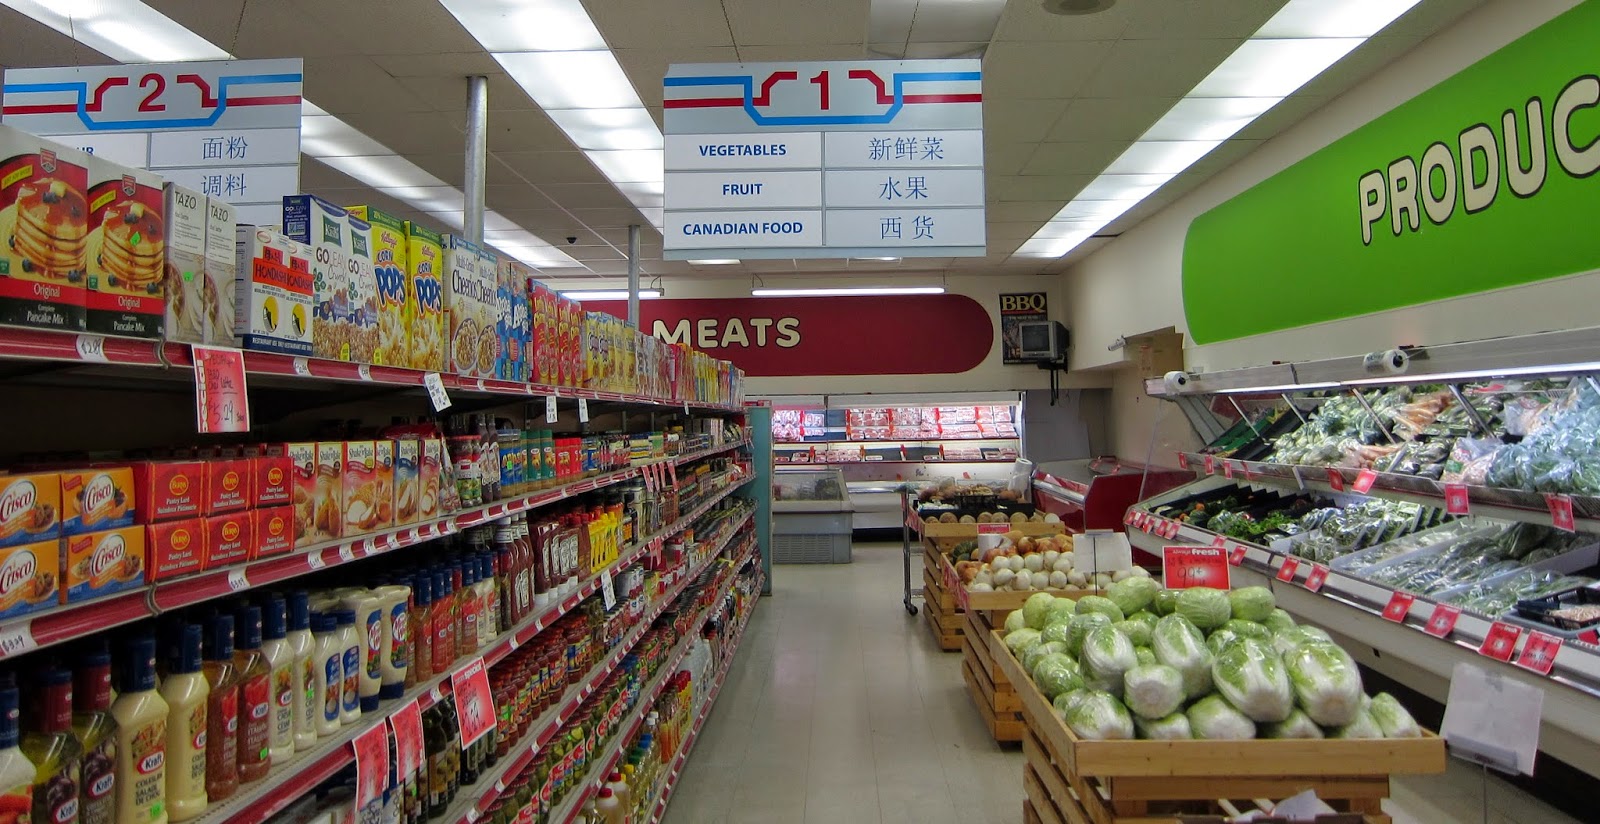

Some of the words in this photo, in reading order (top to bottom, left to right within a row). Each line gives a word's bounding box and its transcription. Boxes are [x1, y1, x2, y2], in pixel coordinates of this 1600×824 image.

[138, 73, 166, 112] 2
[810, 71, 828, 110] 1
[202, 135, 248, 160] 面粉
[699, 144, 786, 157] VEGETABLES
[868, 137, 944, 161] 新鲜菜
[201, 173, 247, 197] 调料
[722, 183, 763, 196] FRUIT
[879, 176, 928, 201] 水果
[174, 191, 197, 210] TAZO
[210, 205, 229, 222] TAZO
[683, 223, 759, 236] CANADIAN
[762, 222, 803, 234] FOOD
[377, 249, 393, 262] CORN
[33, 282, 61, 300] Original
[374, 265, 406, 307] POPS
[414, 276, 442, 316] POPS
[118, 295, 141, 310] Original
[1001, 293, 1046, 313] BBQ
[26, 310, 52, 324] Pancake
[52, 314, 65, 325] Mix
[113, 320, 135, 331] Pancake
[135, 322, 145, 332] Mix
[652, 317, 801, 349] MEATS
[0, 490, 32, 523] Crisco
[87, 483, 112, 511] Crisco
[95, 543, 122, 575] Crisco
[0, 560, 32, 595] Crisco
[145, 753, 162, 769] Kraft
[96, 775, 113, 792] Kraft
[60, 800, 77, 819] Kraft
